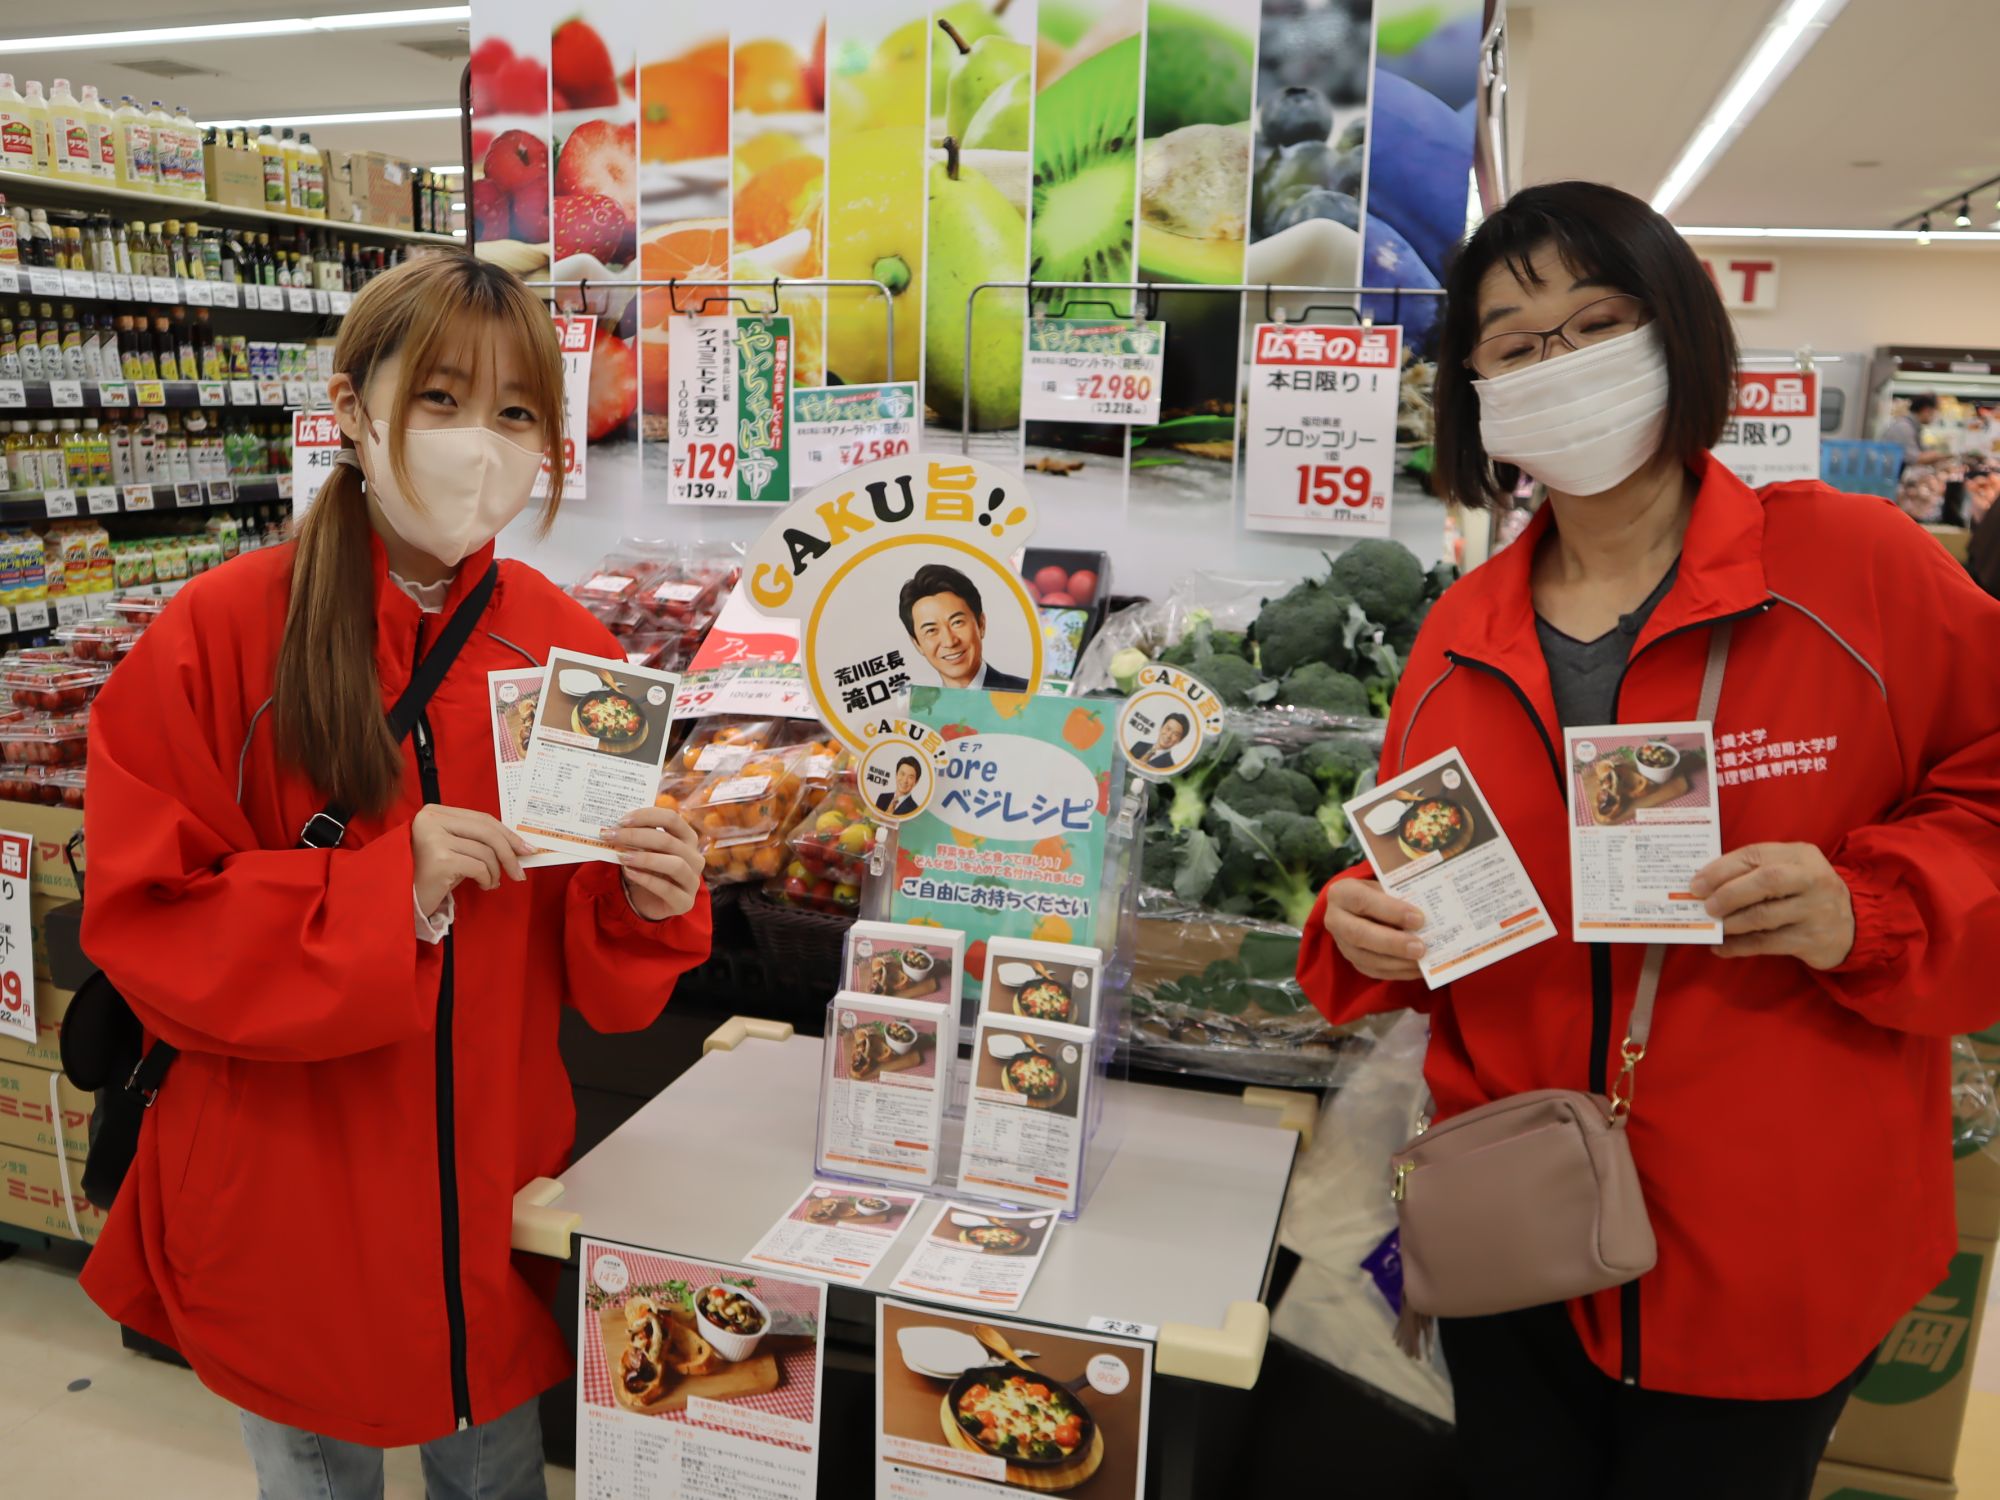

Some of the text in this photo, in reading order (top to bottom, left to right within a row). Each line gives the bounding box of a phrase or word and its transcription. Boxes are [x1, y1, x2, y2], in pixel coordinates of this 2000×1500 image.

[1260, 331, 1390, 363] 広告の品
[1729, 377, 1808, 413] の品
[1265, 426, 1377, 450] ブロッコリー
[307, 450, 341, 468] 本日
[833, 649, 906, 687] 荒川区長
[841, 672, 911, 714] 滝口学
[1715, 728, 1768, 751] 養大学
[1715, 735, 1838, 768] 養大学短期大学部
[941, 788, 1094, 830] ベジレシピ
[902, 878, 1089, 916] ご自由にお持ちください
